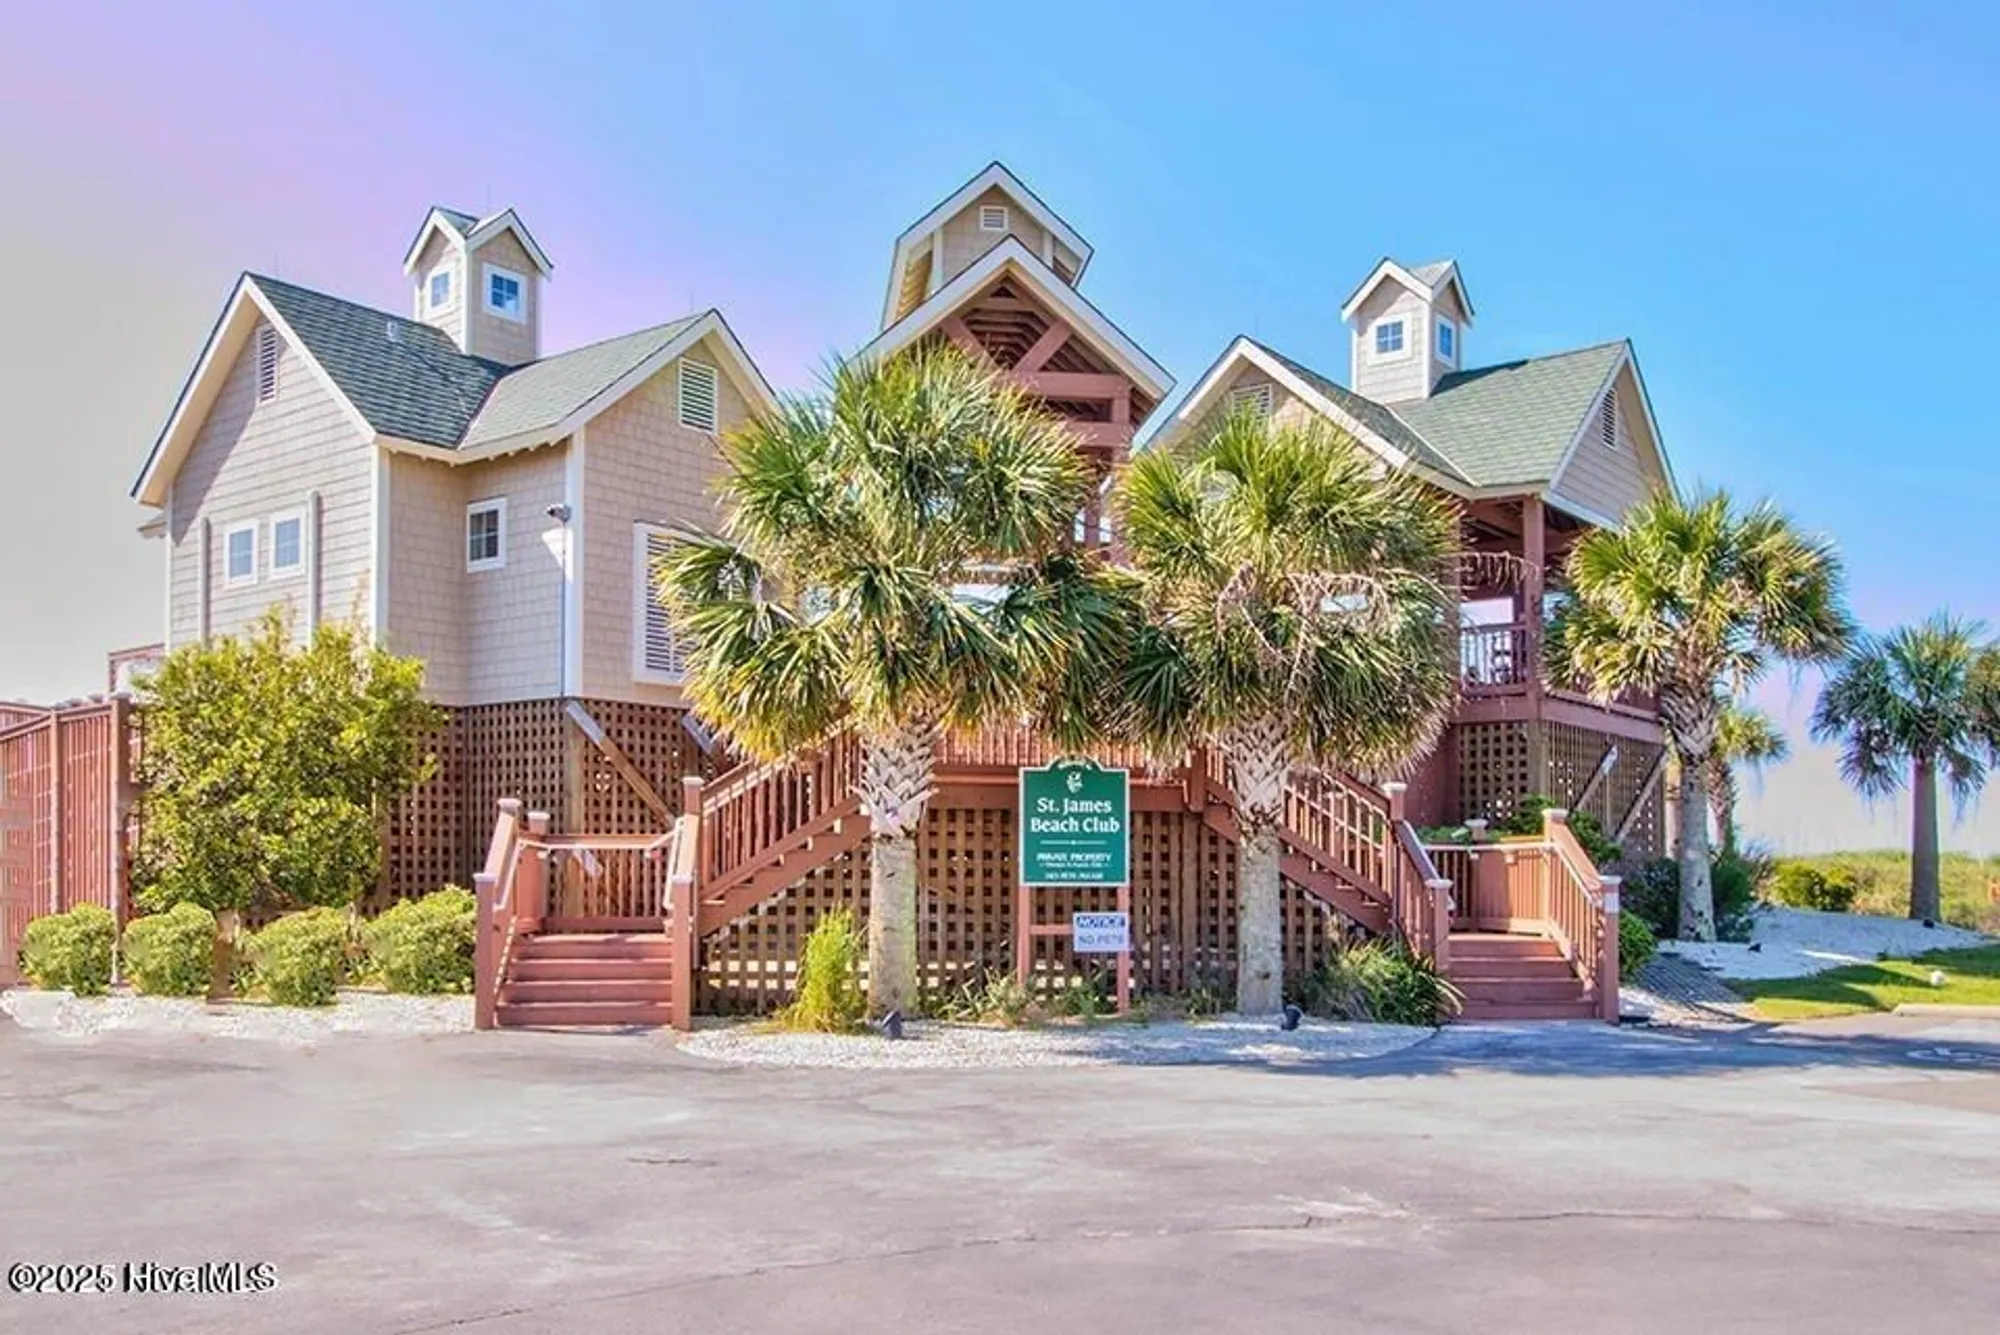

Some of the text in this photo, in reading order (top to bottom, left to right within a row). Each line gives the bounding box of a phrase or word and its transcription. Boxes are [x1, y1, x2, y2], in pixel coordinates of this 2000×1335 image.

[1037, 798, 1112, 816] St. James
[1031, 817, 1120, 833] Beach Club
